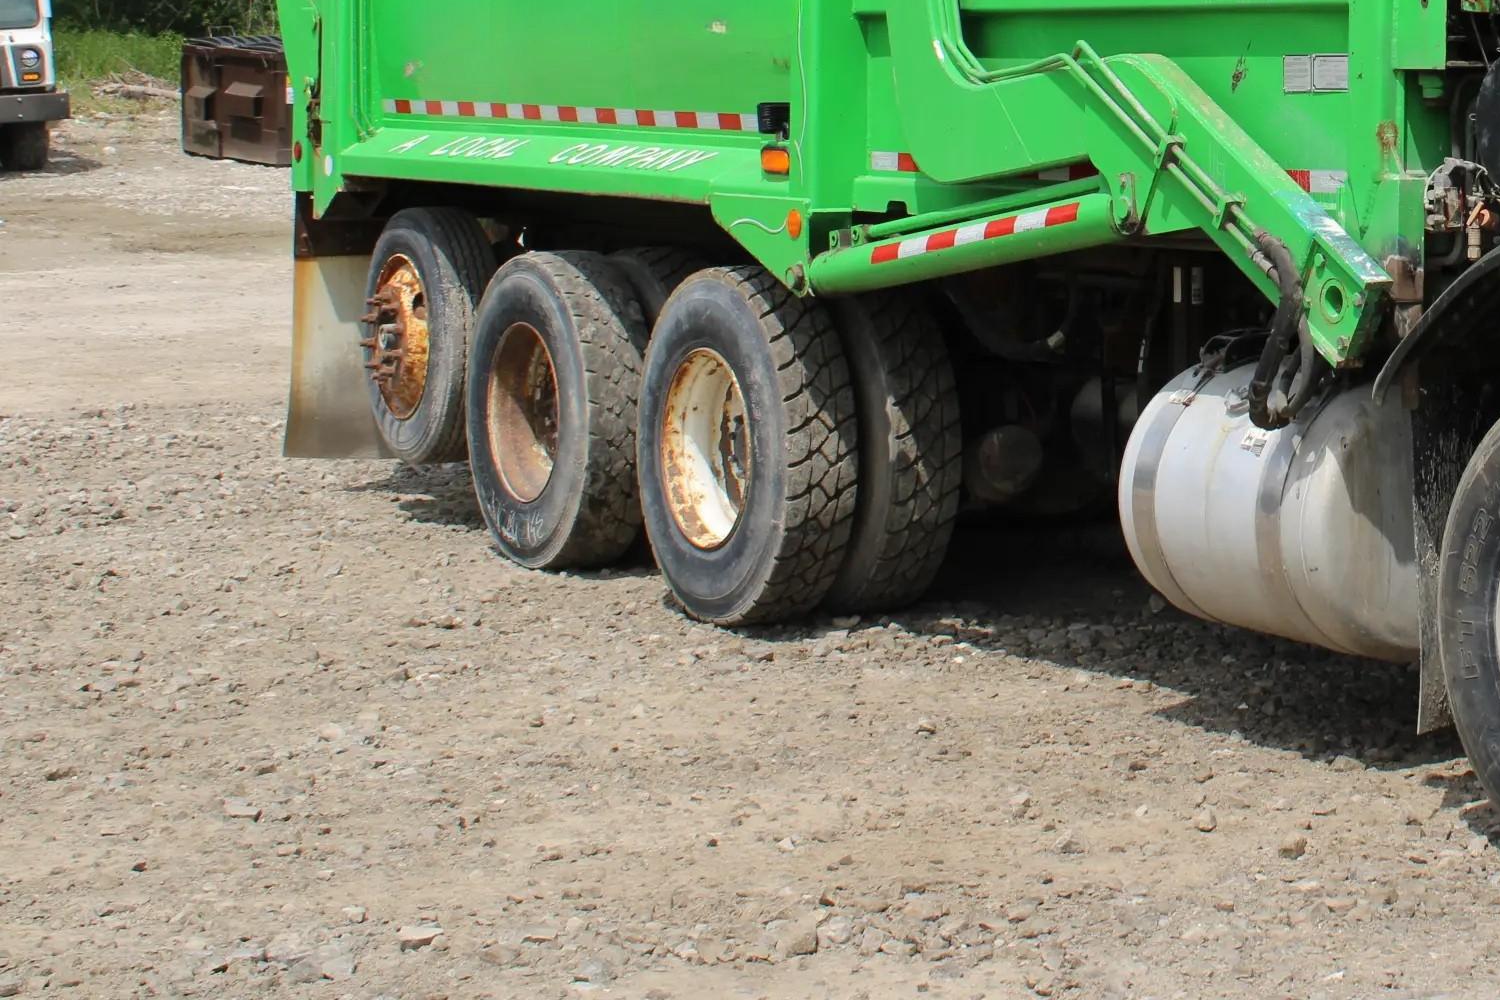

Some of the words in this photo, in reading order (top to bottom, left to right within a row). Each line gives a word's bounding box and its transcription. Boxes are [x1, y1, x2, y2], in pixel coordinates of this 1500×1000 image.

[390, 135, 429, 154] A
[430, 135, 530, 159] LOCAL
[547, 142, 720, 172] COMPANY
